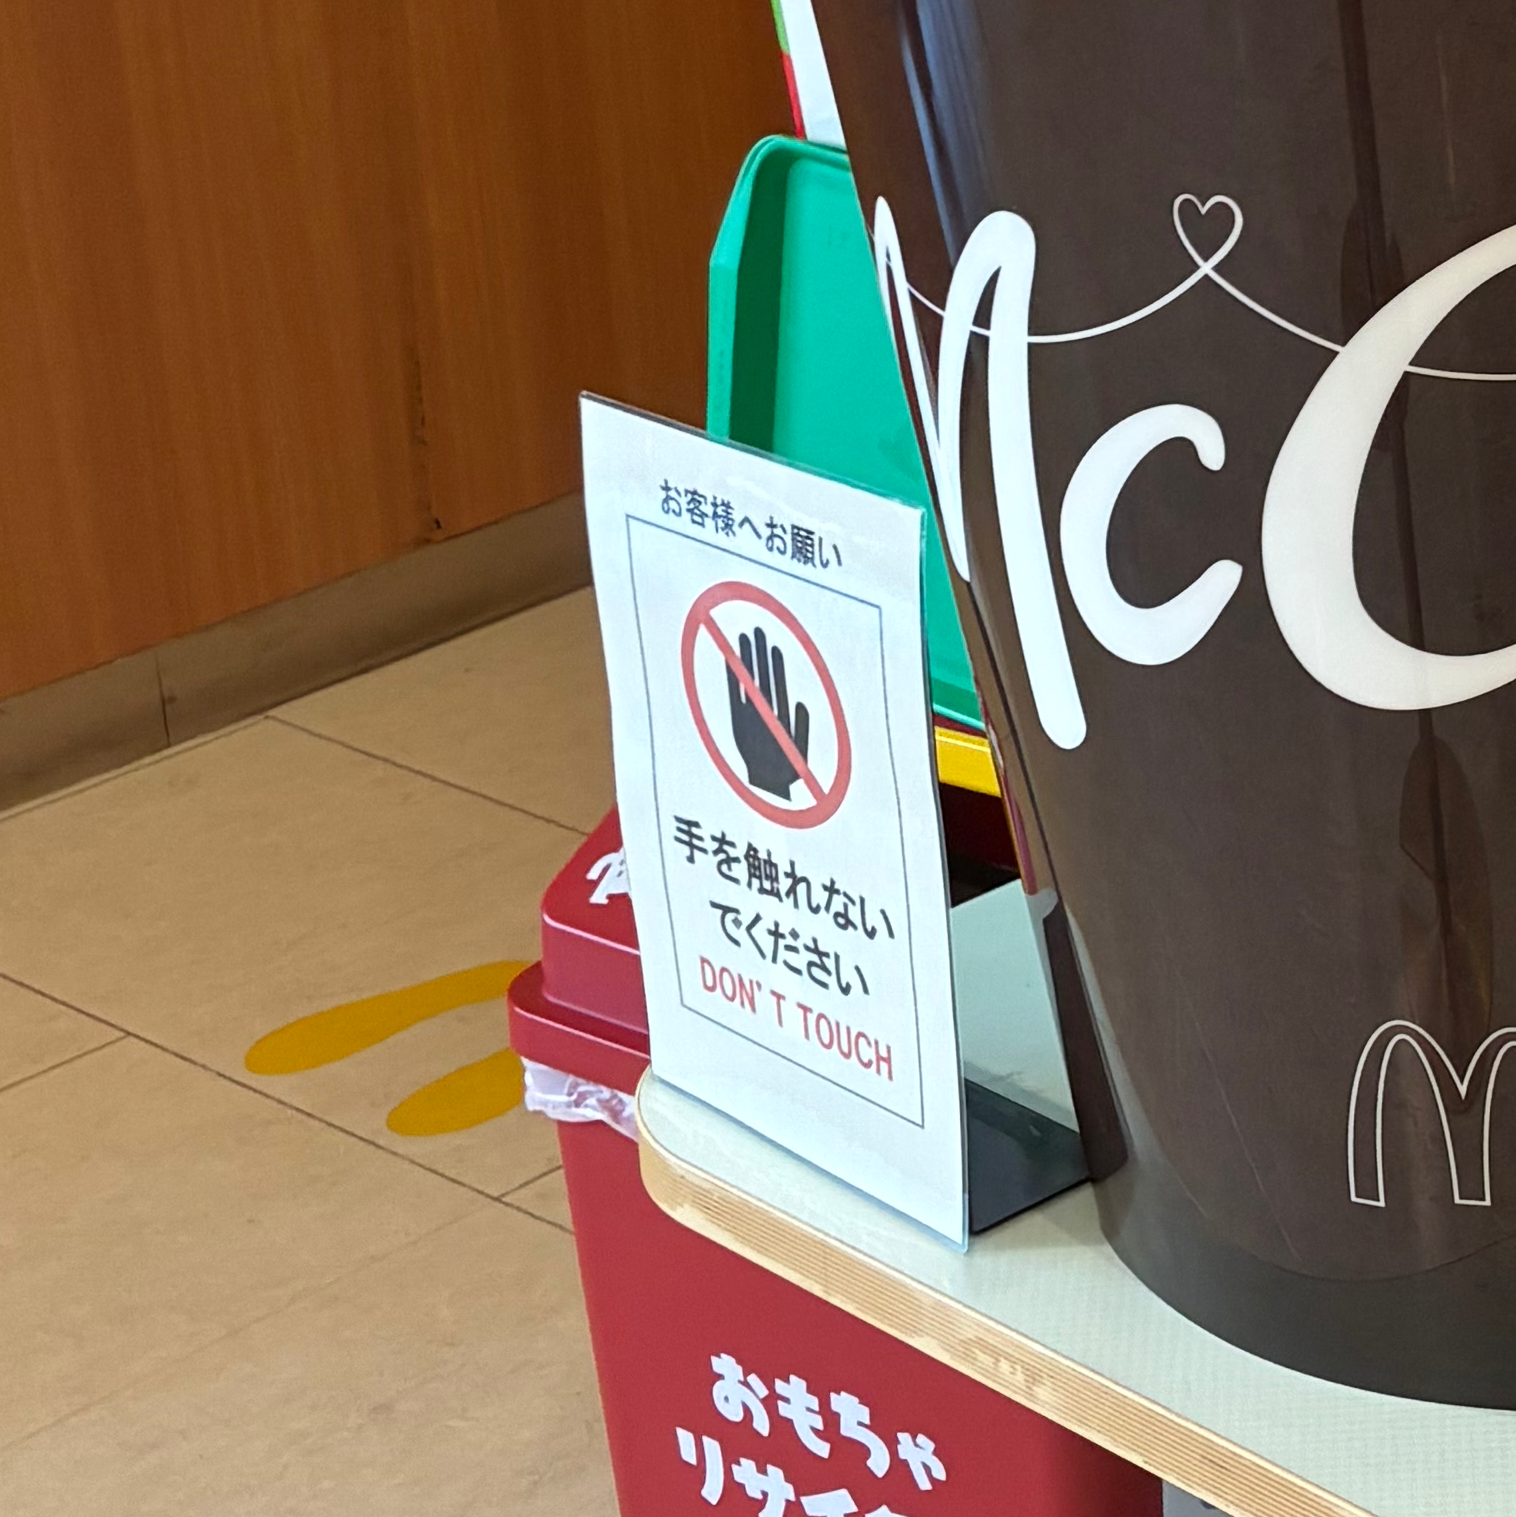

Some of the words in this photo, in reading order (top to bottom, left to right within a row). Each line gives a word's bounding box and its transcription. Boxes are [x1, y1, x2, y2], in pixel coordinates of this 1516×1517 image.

[659, 478, 843, 569] お客様へお願い
[673, 815, 895, 940] 手を触れない
[709, 900, 870, 996] でください
[796, 1001, 894, 1082] TOUCH
[709, 1352, 946, 1491] おもちゃ
